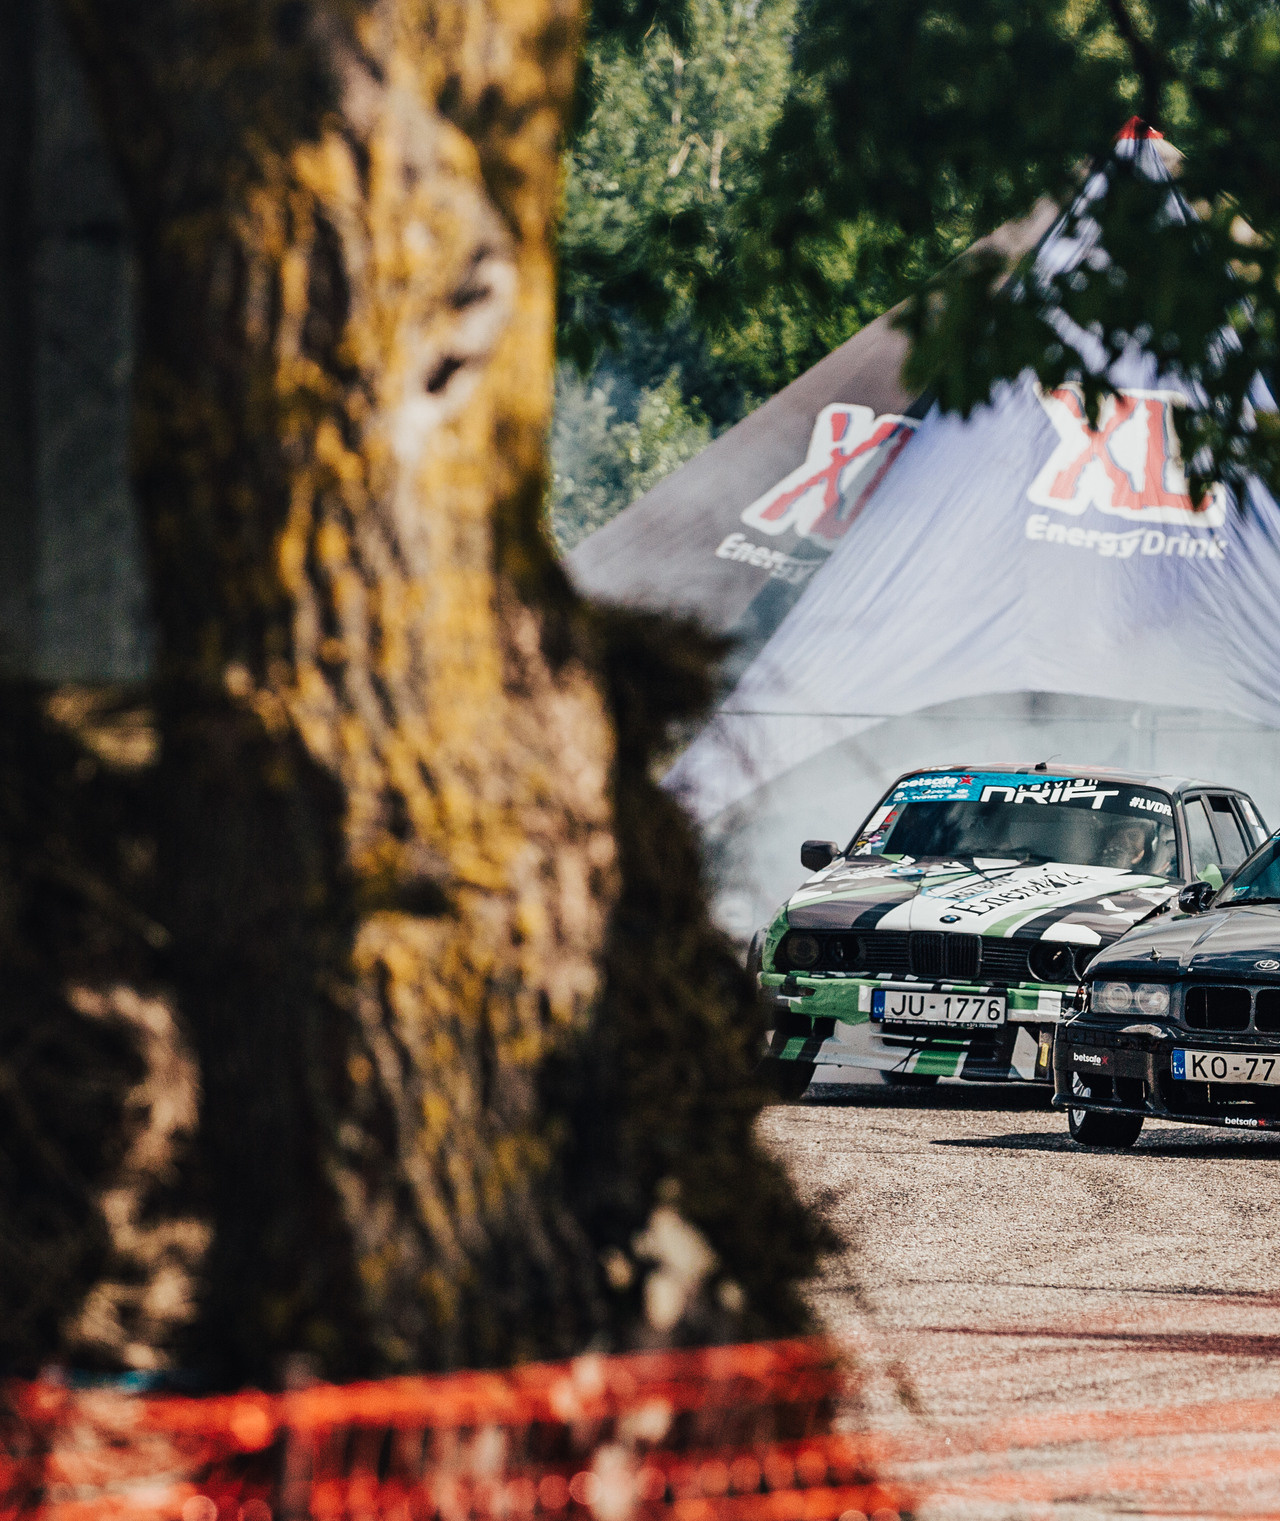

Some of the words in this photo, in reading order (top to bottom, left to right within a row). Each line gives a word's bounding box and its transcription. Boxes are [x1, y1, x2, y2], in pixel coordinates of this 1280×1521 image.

[1027, 383, 1226, 526] XL
[1129, 796, 1174, 818] #LVDR
[874, 1006, 884, 1014] LV
[890, 994, 1001, 1021] JU-1776
[1073, 1052, 1102, 1064] betsafe
[1173, 1067, 1184, 1075] LV
[1225, 1116, 1258, 1127] betsafe
